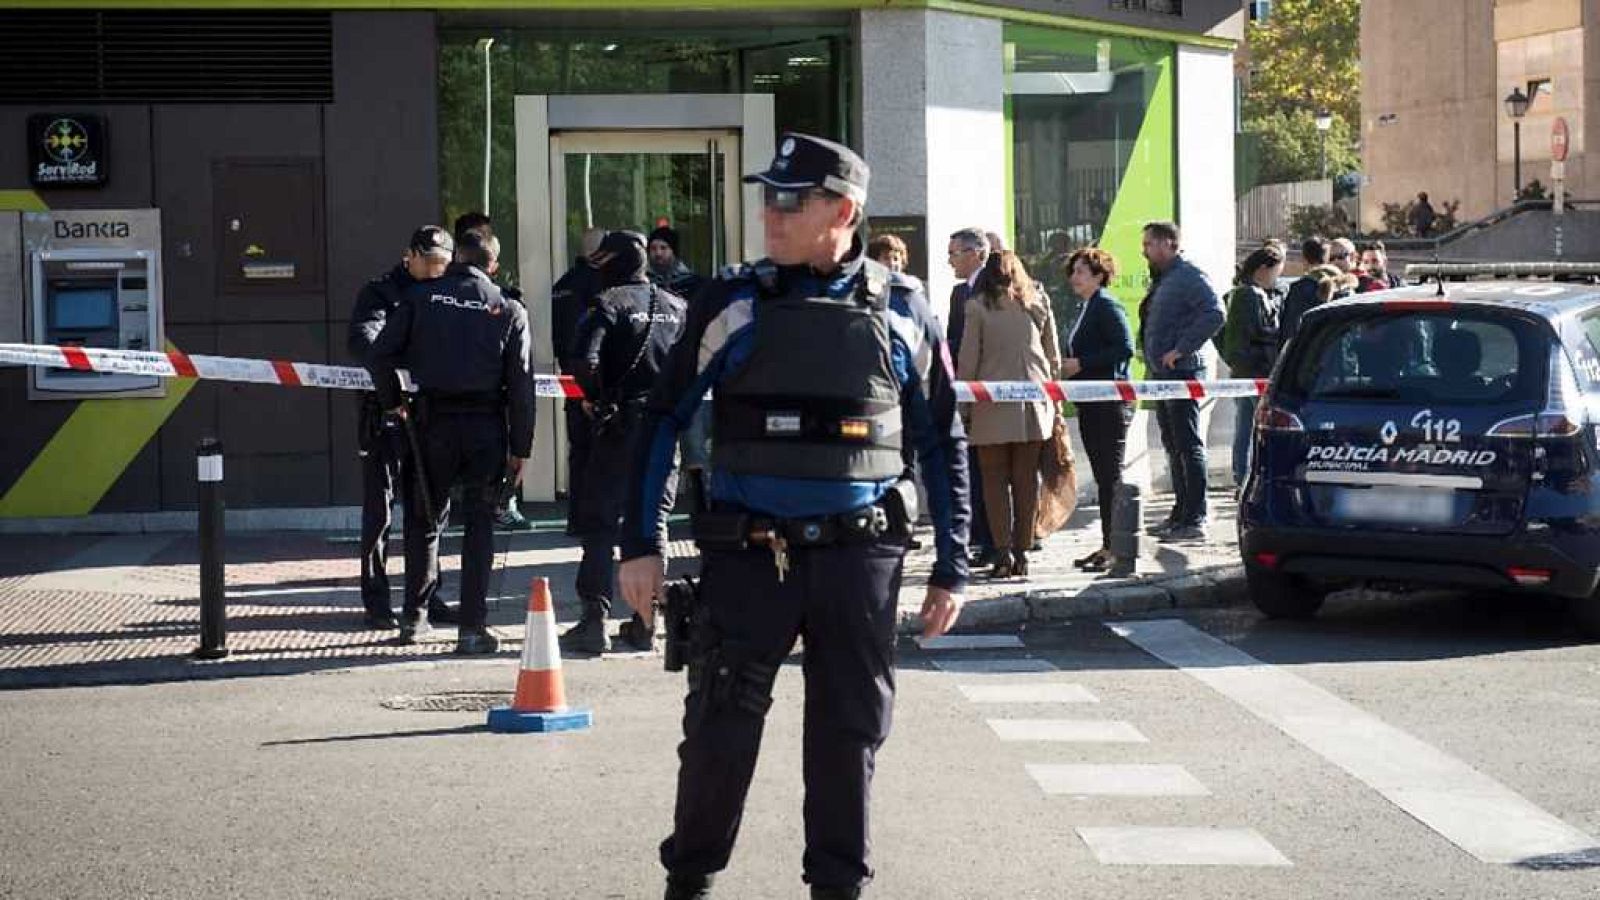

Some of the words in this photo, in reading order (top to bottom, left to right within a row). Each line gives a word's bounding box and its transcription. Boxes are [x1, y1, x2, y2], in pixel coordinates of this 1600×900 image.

[54, 220, 130, 239] Bankia
[1422, 419, 1461, 442] 112
[1307, 460, 1369, 471] MUNICIPAL
[1391, 448, 1497, 465] MADRID
